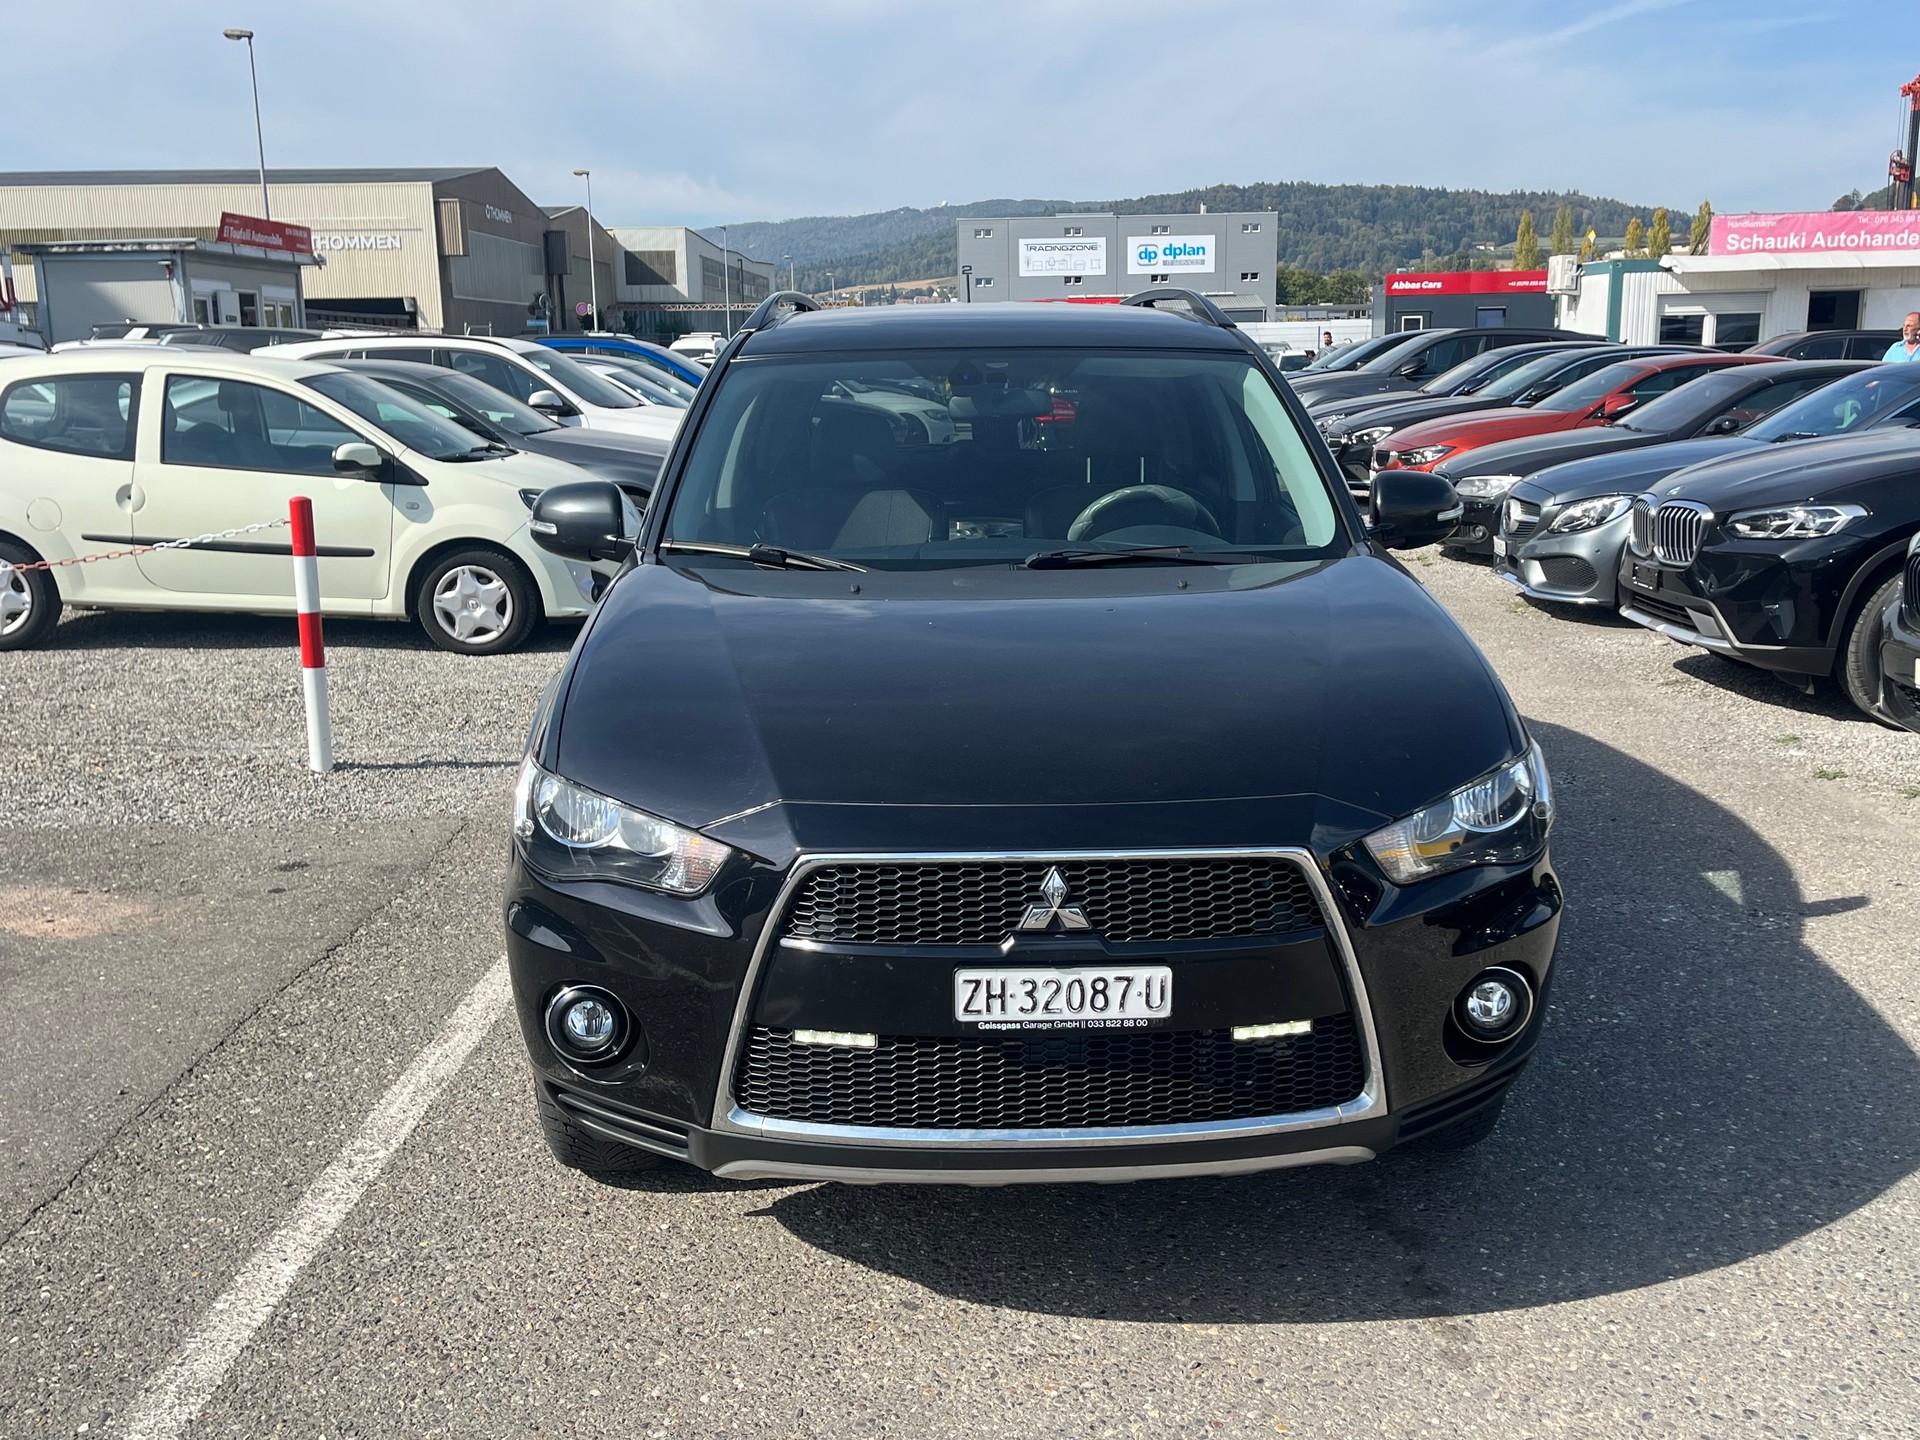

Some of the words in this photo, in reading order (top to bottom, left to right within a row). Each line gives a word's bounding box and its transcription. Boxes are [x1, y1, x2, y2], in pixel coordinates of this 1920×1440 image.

[312, 235, 402, 250] THOMMEN
[1024, 242, 1098, 252] TRADINGZONE
[1726, 232, 1806, 250] Schauki
[1138, 247, 1158, 263] dp
[1163, 243, 1206, 259] dplan
[1391, 281, 1421, 290] Abbas
[1421, 281, 1443, 289] Cars
[978, 1021, 1021, 1031] Geissgass
[1022, 1021, 1053, 1030] Garage
[1053, 1020, 1080, 1029] GmbH
[1087, 1020, 1104, 1028] 033
[1105, 1020, 1121, 1028] 822
[1136, 1019, 1149, 1027] 00
